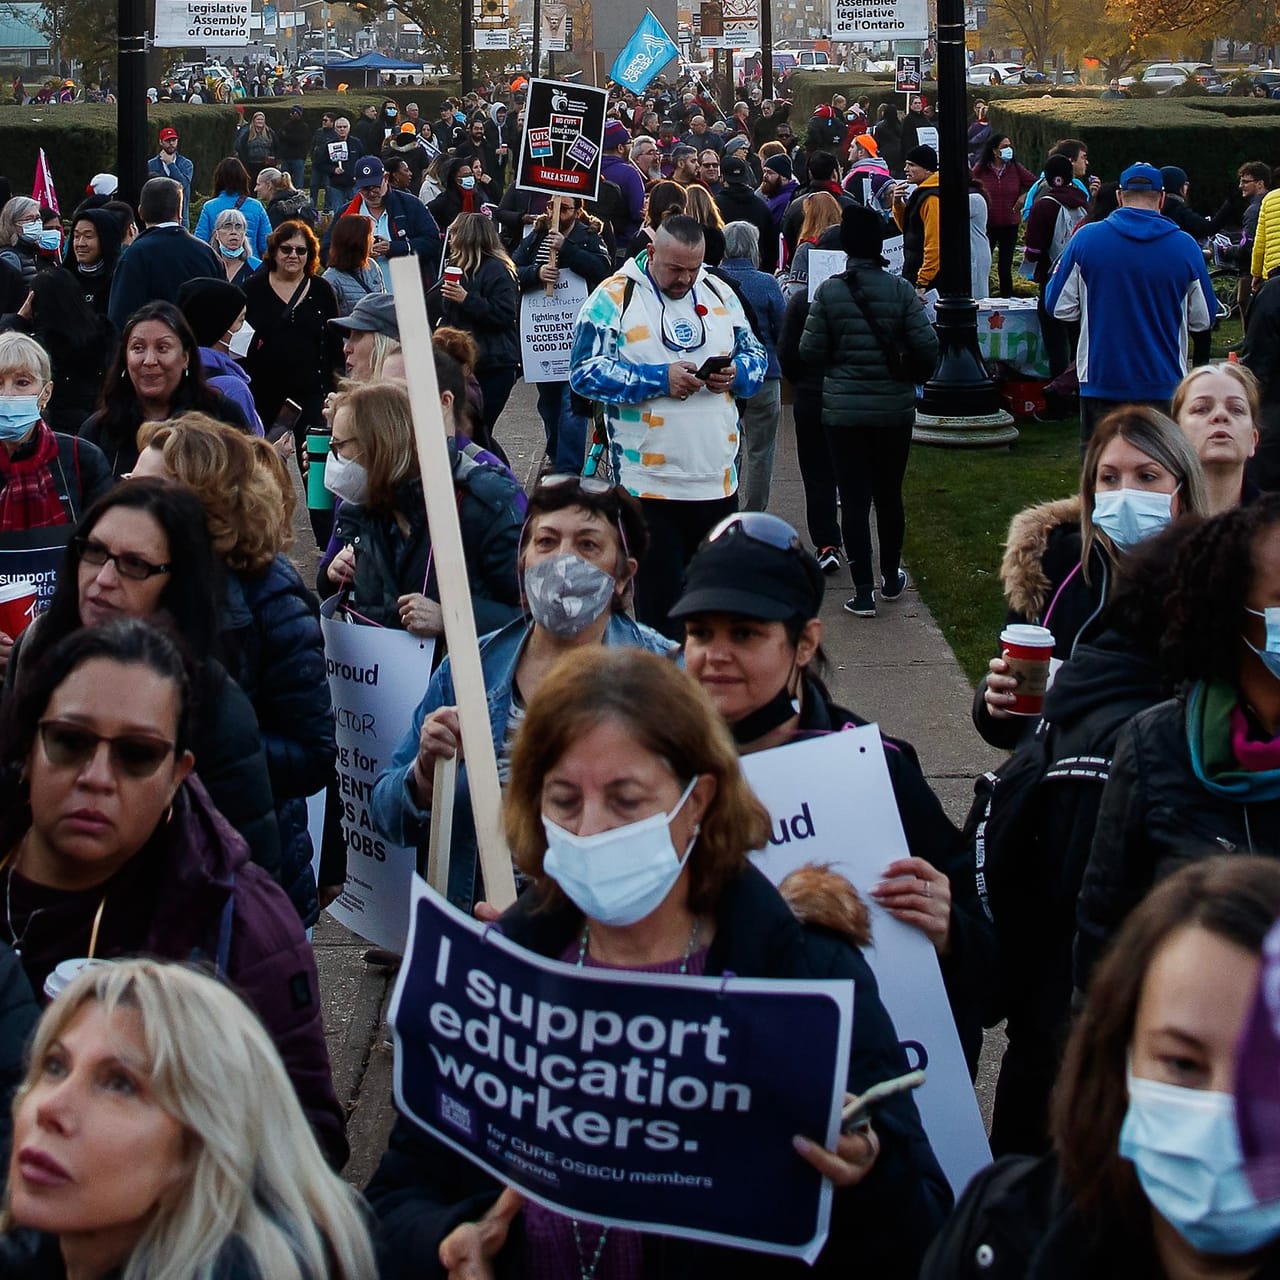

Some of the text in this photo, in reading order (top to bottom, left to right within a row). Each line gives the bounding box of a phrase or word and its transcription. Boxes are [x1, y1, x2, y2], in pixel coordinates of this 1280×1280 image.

[187, 3, 247, 15] Legislative
[837, 8, 894, 20] législative
[193, 15, 247, 26] Assembly
[837, 20, 904, 31] de l'Ontario
[187, 27, 246, 37] of Ontario
[531, 132, 549, 141] CUTS
[540, 170, 554, 180] TAKE
[560, 174, 580, 184] STAND
[531, 311, 574, 323] fighting for
[534, 322, 573, 333] STUDENT
[526, 333, 565, 343] SUCCESS
[532, 343, 557, 352] GOOD
[326, 658, 379, 686] proud
[353, 747, 378, 773] for
[435, 935, 731, 1065] I support
[428, 1000, 753, 1113] education
[428, 1042, 700, 1153] workers.
[487, 1122, 508, 1143] for
[628, 1170, 714, 1188] members
